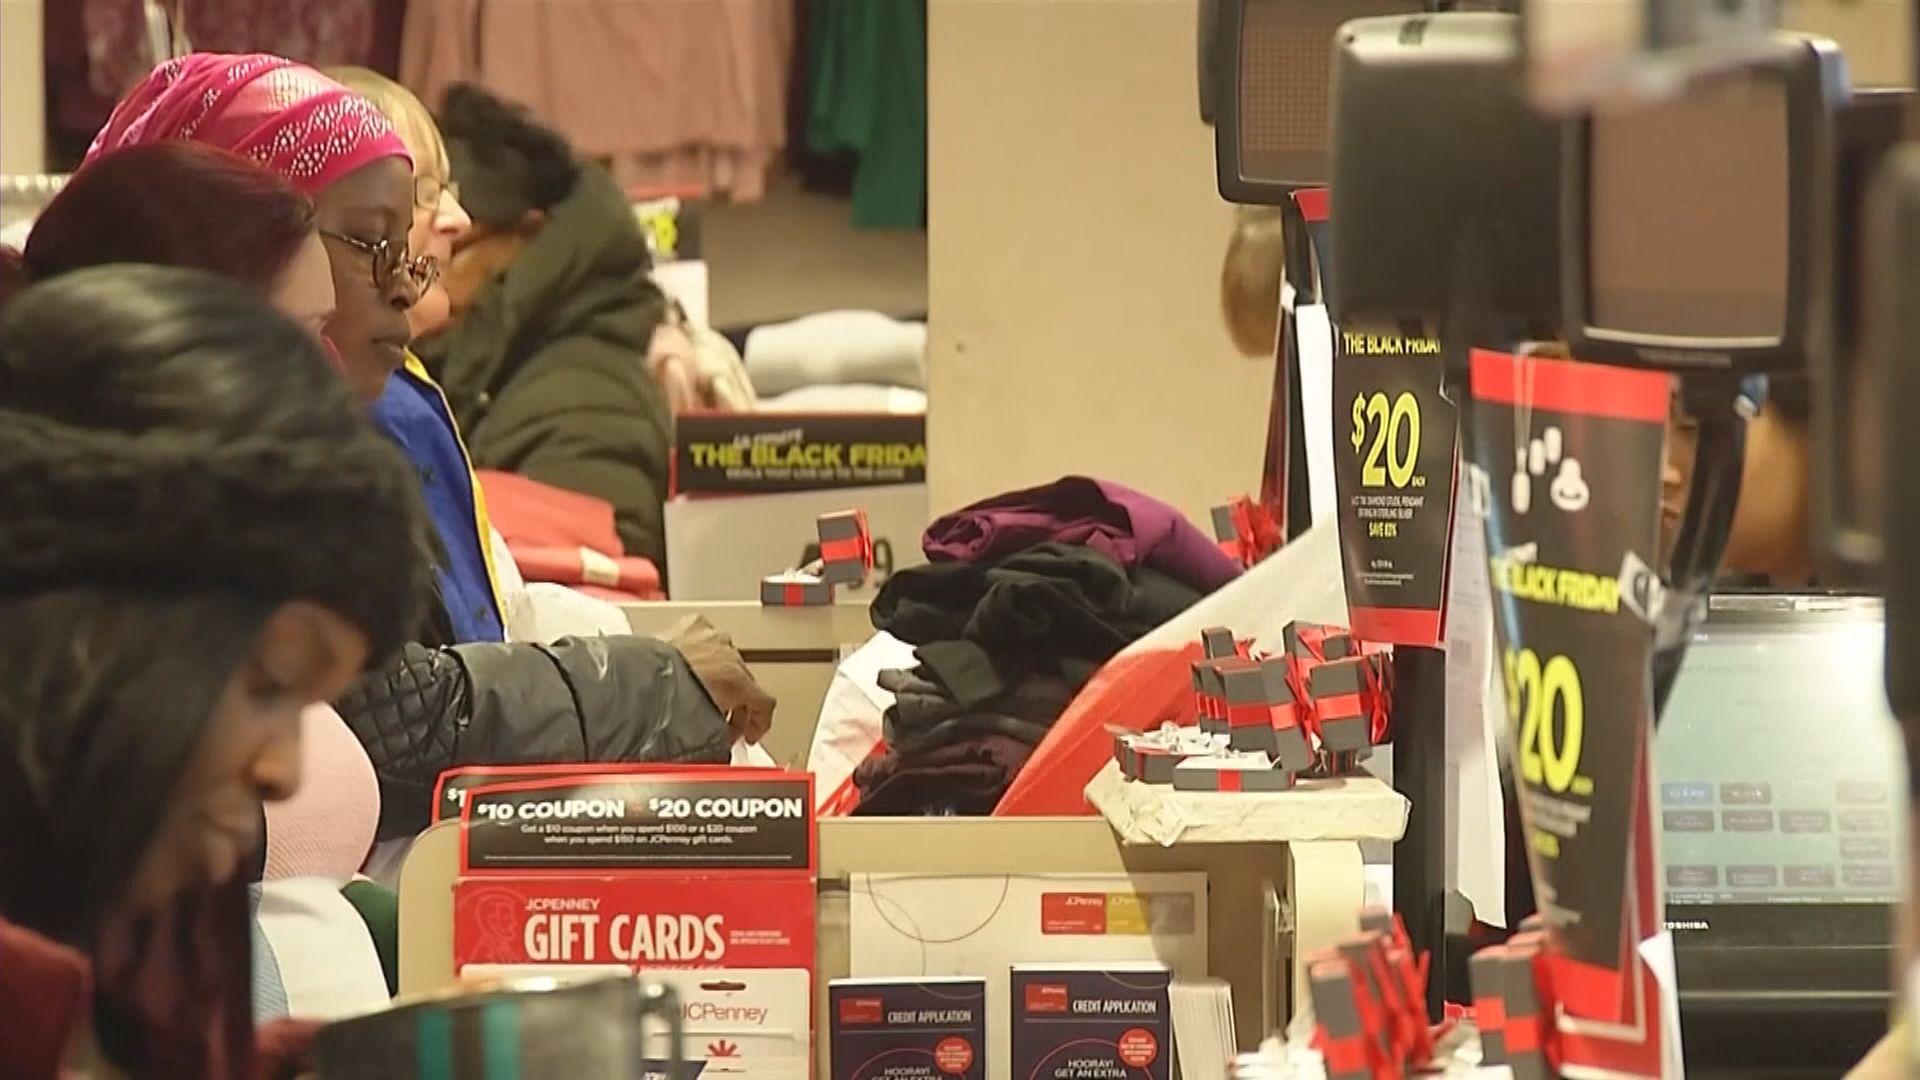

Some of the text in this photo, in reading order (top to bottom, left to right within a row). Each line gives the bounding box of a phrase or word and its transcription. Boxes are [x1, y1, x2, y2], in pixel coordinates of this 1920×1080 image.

[1343, 332, 1365, 355] THE
[1367, 336, 1403, 355] BLACK
[1351, 391, 1420, 489] $20
[689, 443, 743, 468] THE
[751, 443, 842, 468] BLACK
[477, 802, 515, 820] $10
[518, 799, 625, 819] COUPON
[649, 798, 692, 819] $20
[695, 798, 803, 819] COUPON
[562, 824, 595, 836] coupon
[596, 824, 619, 834] when
[621, 824, 637, 836] you
[725, 824, 758, 836] coupon
[544, 835, 568, 844] when
[569, 837, 585, 846] you
[525, 898, 600, 911] JCPENNEY
[524, 914, 726, 960] GIFT CARDS
[683, 1002, 768, 1025] JCPenney
[1072, 999, 1157, 1013] CREDIT APPLICATION
[887, 1009, 972, 1024] CREDIT APPLICATION
[884, 1066, 931, 1076] HOORAY!
[1068, 1059, 1114, 1068] HOORAY!
[1054, 1068, 1128, 1079] GET AN EXTRA
